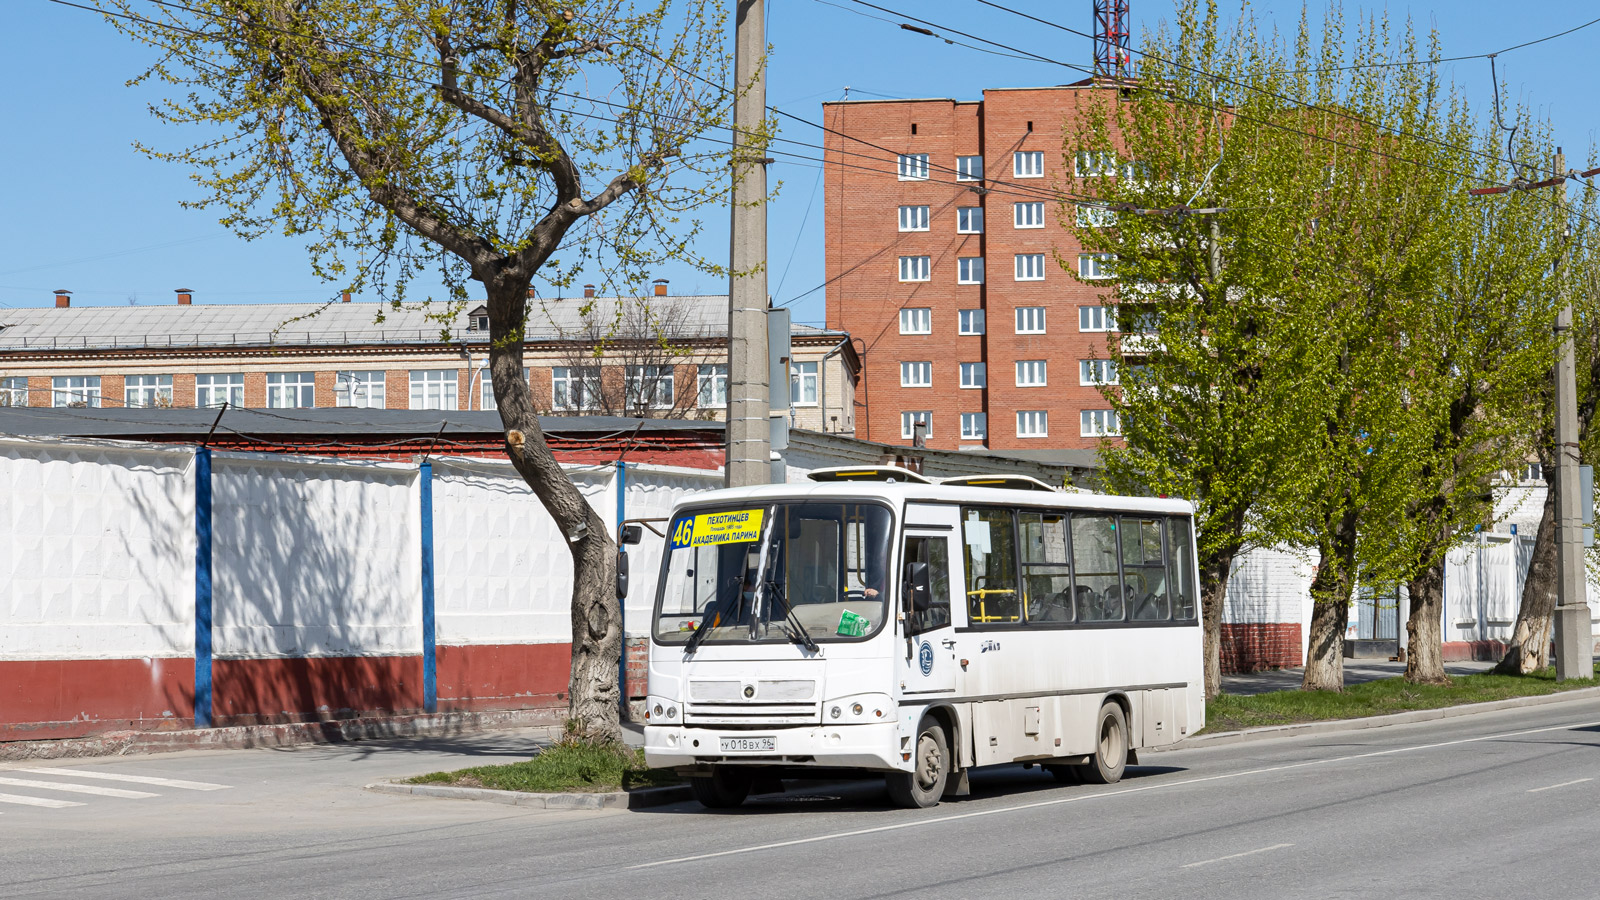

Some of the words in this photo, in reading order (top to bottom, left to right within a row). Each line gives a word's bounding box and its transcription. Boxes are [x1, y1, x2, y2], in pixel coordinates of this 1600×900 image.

[707, 513, 749, 525] ПЕХОТИНЦЕВ
[673, 519, 693, 546] 46
[693, 534, 730, 545] АКАДЕМИКА
[731, 530, 757, 541] ПАРИНА
